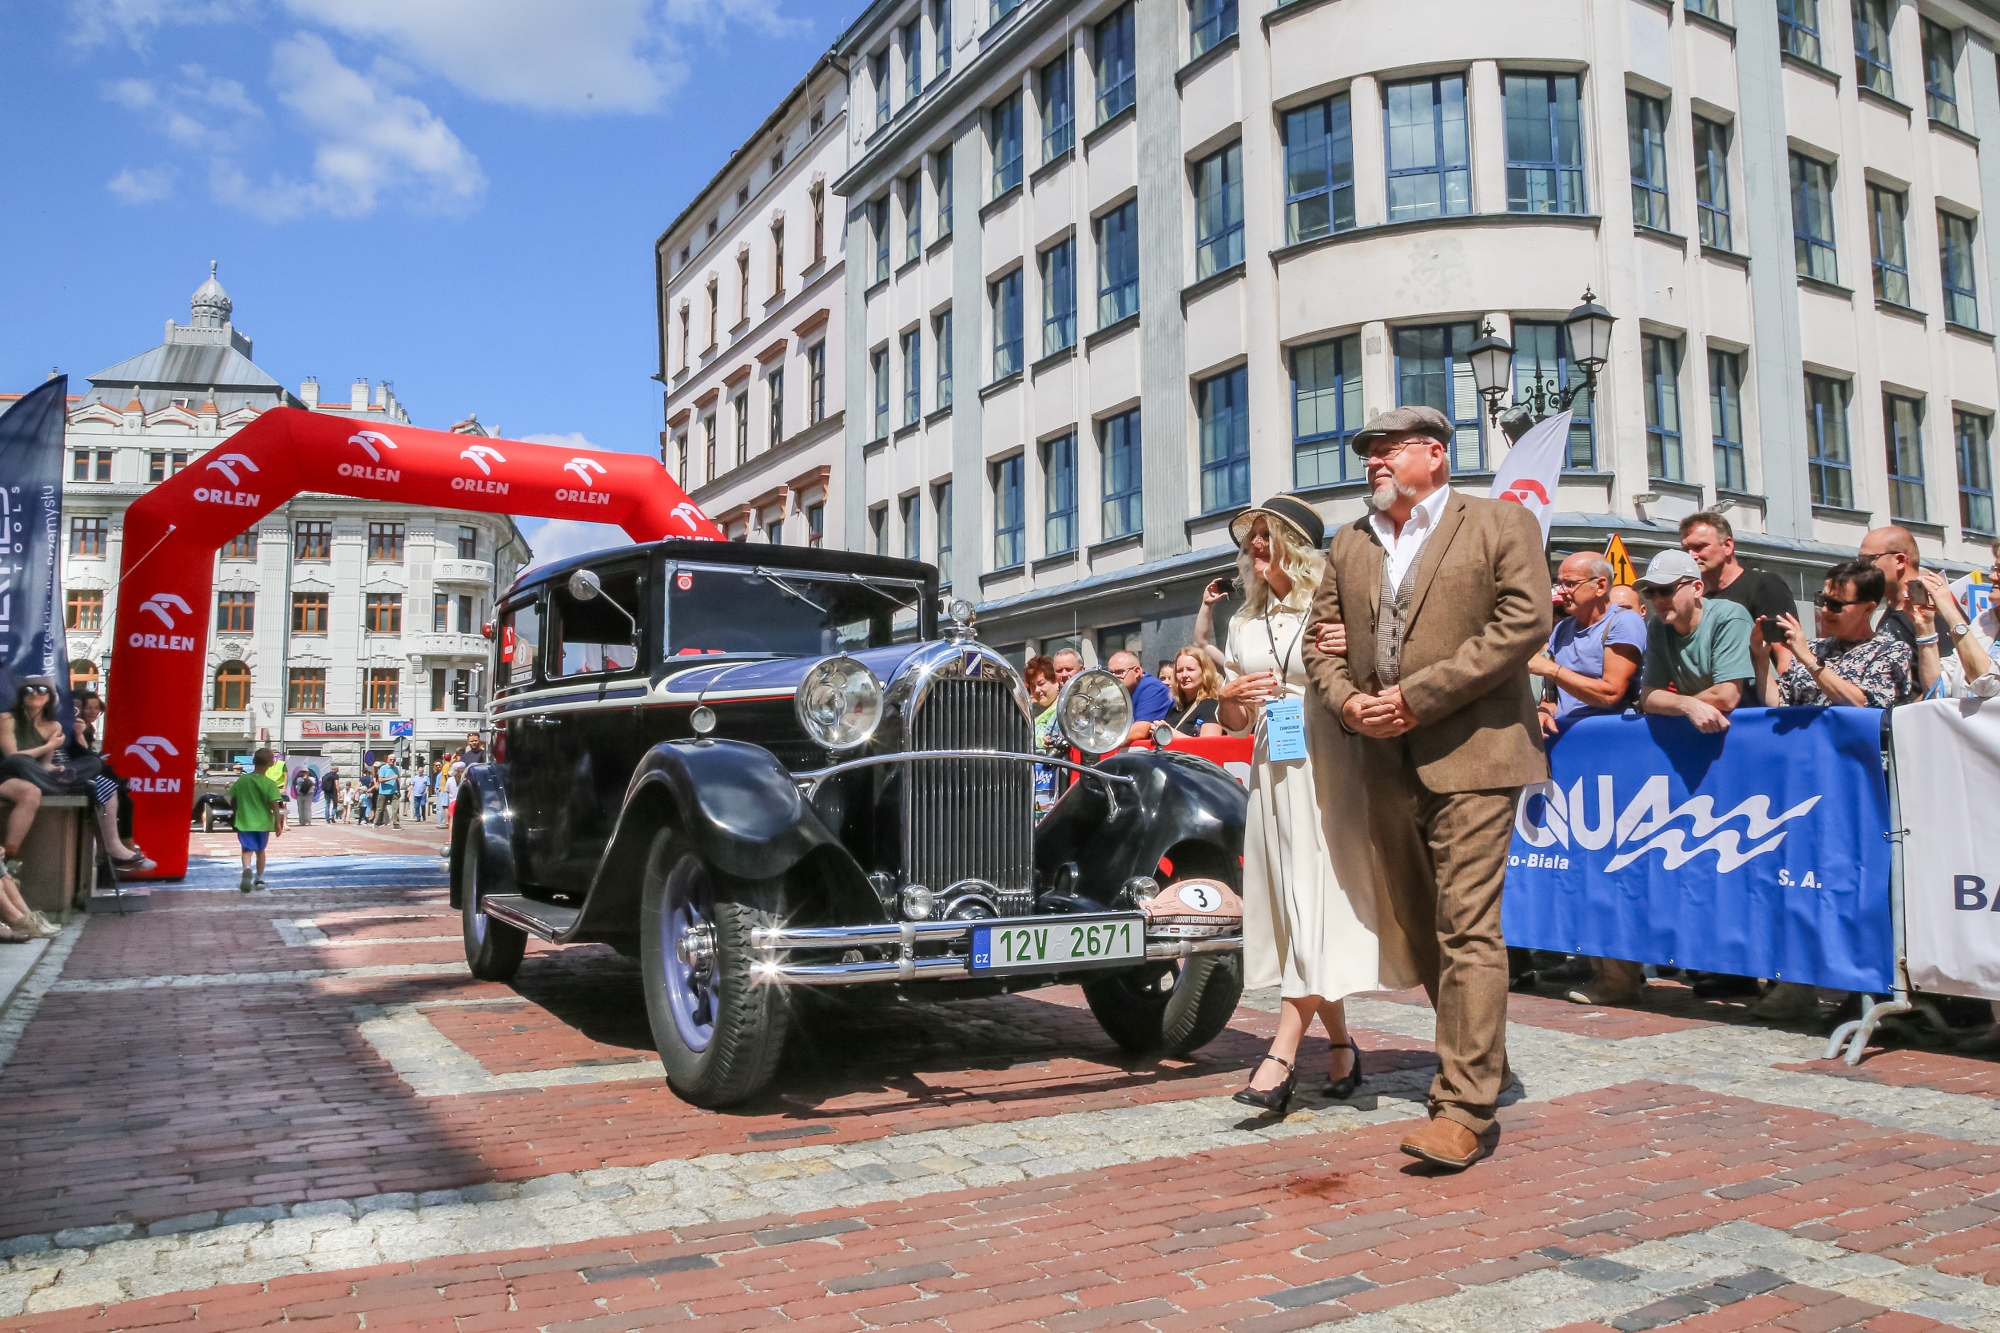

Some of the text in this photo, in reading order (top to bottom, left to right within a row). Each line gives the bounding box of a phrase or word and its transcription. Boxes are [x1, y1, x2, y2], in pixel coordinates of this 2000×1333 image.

[337, 462, 401, 483] ORLEN
[451, 477, 510, 495] ORLEN
[193, 487, 261, 507] ORLEN
[555, 488, 611, 505] ORLEN
[11, 486, 23, 573] TOOLS
[129, 633, 195, 651] ORLEN
[325, 722, 381, 732] Bank Pekao
[128, 777, 181, 793] RLEN
[1506, 853, 1570, 870] o-Biała
[1193, 888, 1208, 908] 3
[1953, 874, 2000, 912] B
[1000, 923, 1131, 962] 12V 2671
[975, 953, 989, 964] CZ
